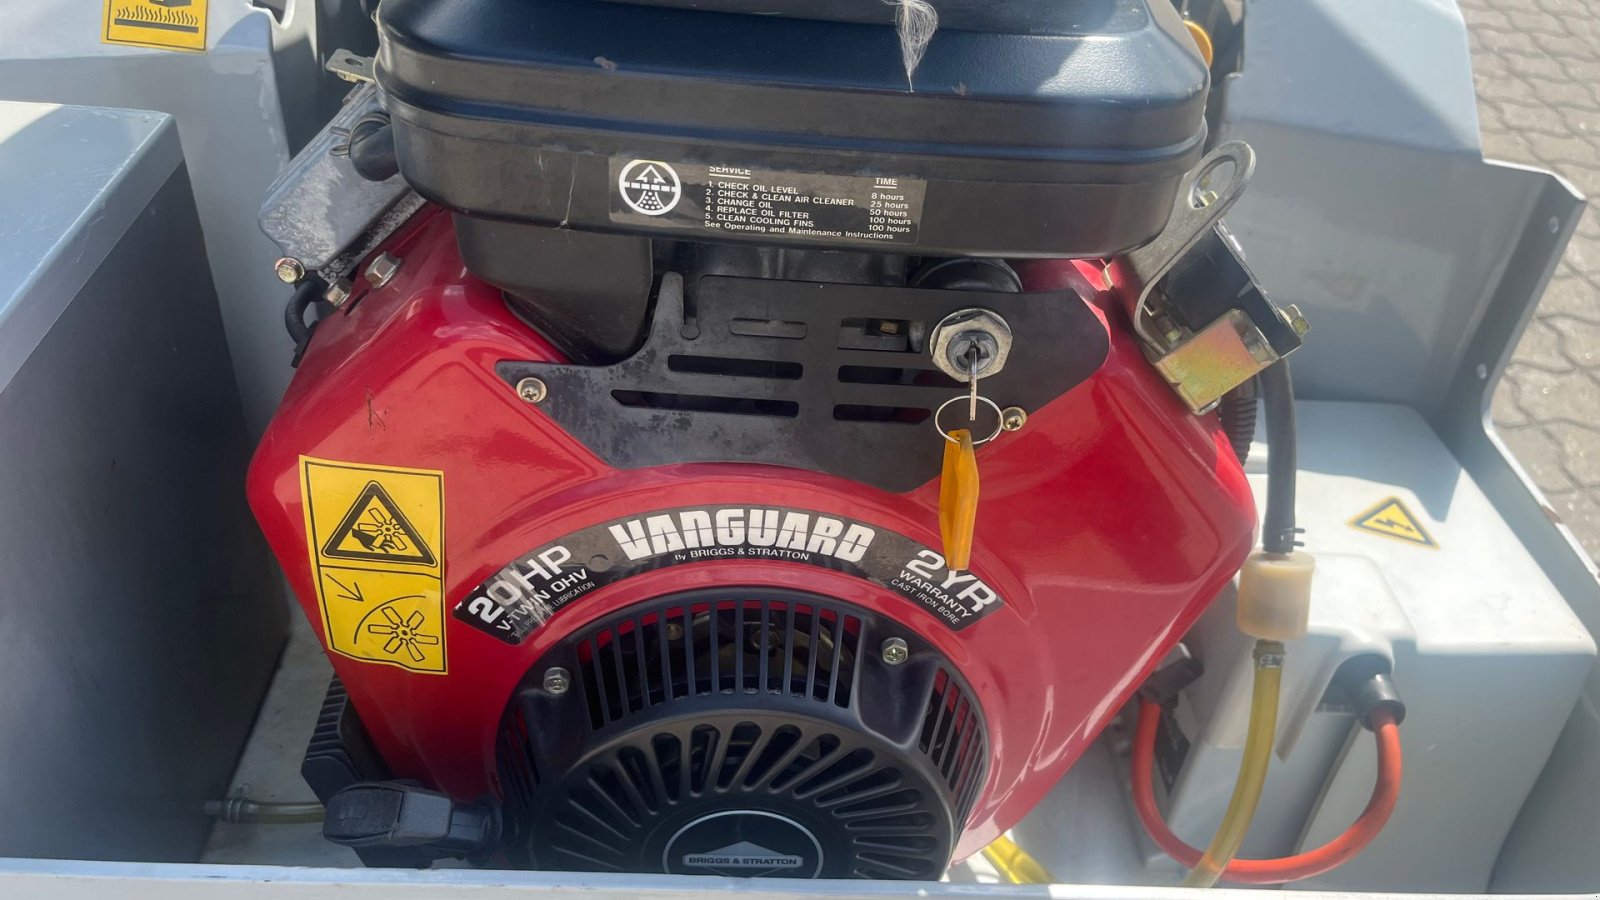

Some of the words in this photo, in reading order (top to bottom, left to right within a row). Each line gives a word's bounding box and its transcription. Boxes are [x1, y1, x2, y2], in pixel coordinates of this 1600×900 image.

[709, 166, 751, 175] SERVICE
[718, 181, 749, 191] CHECK
[752, 184, 767, 192] OIL
[771, 186, 799, 195] LEVEL
[875, 177, 898, 186] TIME
[706, 188, 714, 196] 2.
[717, 190, 749, 199] CHECK
[752, 192, 758, 200] &
[761, 193, 791, 202] CLEAN
[812, 197, 854, 206] CLEANER
[717, 198, 755, 208] CHANGE
[758, 201, 773, 209] OIL
[880, 193, 904, 201] hours
[870, 200, 882, 208] 25
[884, 201, 909, 209] hours
[717, 206, 758, 216] REPLACE
[761, 209, 776, 217] OIL
[779, 211, 810, 219] FILTER
[869, 208, 881, 216] 50
[883, 209, 908, 217] hours
[705, 212, 713, 220] 5.
[717, 213, 746, 222] CLEAN
[750, 216, 790, 226] COOLING
[794, 219, 814, 228] FINS
[888, 217, 912, 225] hours
[704, 220, 721, 228] See
[724, 222, 766, 233] Operating
[788, 227, 842, 237] Maintenance
[845, 230, 894, 240] Instructions
[869, 224, 884, 232] 100
[887, 225, 911, 233] hours
[608, 508, 876, 562] VANGUARD
[690, 548, 735, 559] BRIGGS
[748, 548, 810, 561] STRATTON
[468, 545, 572, 624] 20HP
[906, 549, 997, 613] 2YR
[496, 590, 551, 631] V-TWIN
[550, 568, 588, 592] OHV
[553, 581, 595, 607] LUBRICATION
[900, 570, 972, 618] WARRANTY
[891, 579, 917, 594] CAST
[916, 591, 938, 608] IRON
[937, 606, 960, 625] BORE
[688, 857, 730, 865] BRIGGS
